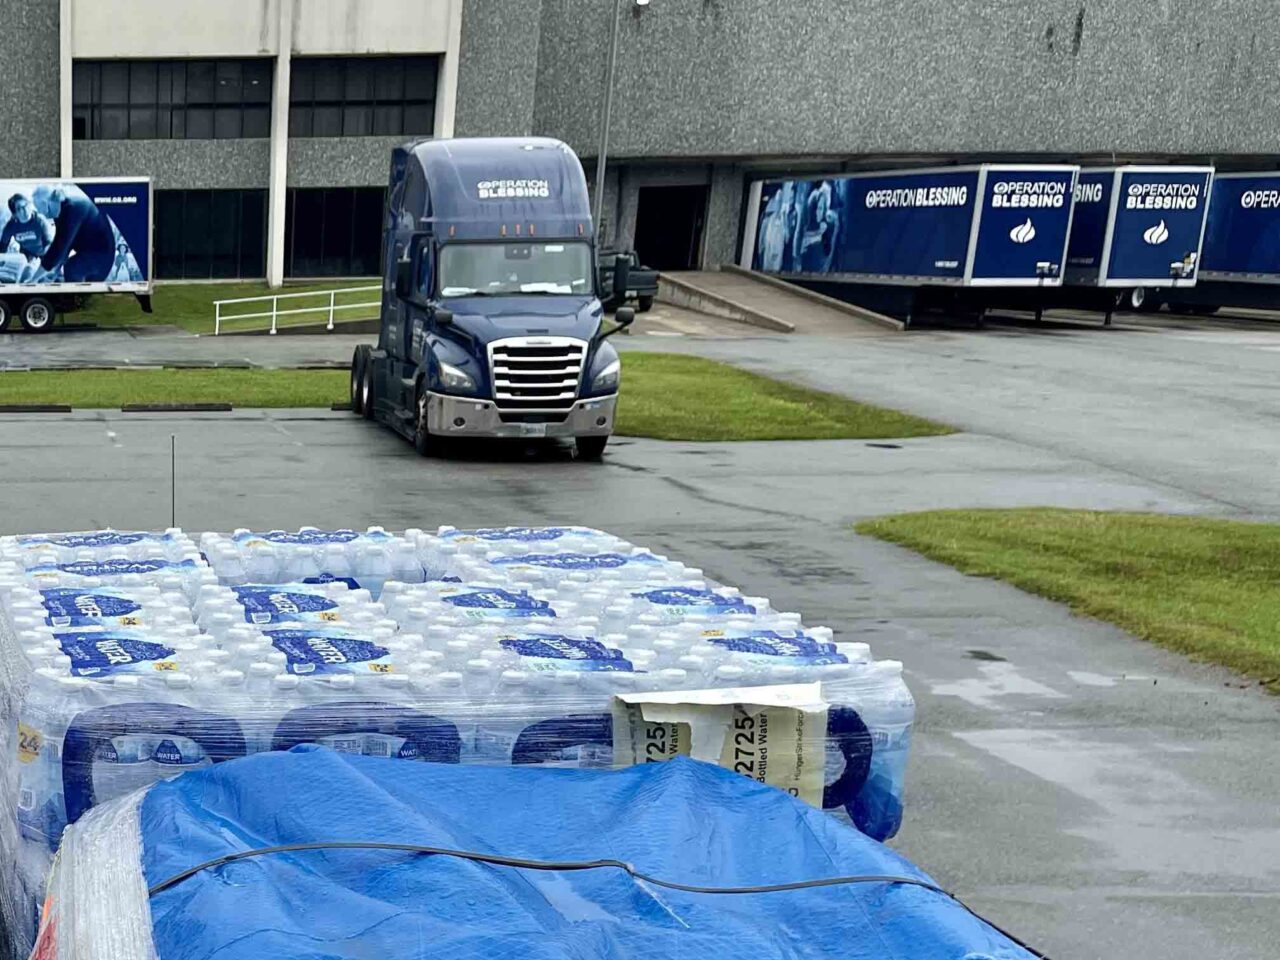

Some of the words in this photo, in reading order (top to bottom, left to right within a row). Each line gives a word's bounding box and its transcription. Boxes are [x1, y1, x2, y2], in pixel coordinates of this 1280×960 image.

[477, 179, 548, 189] OPERATION
[993, 181, 1066, 195] OPERATION
[1127, 183, 1200, 196] OPERATION
[479, 187, 549, 198] BLESSING
[866, 189, 916, 208] OPERATION
[915, 186, 967, 207] BLESSING
[991, 194, 1064, 208] BLESSING
[1126, 196, 1197, 209] BLESSING
[95, 639, 133, 665] WATER
[307, 637, 348, 664] WATER
[758, 713, 768, 745] Water
[734, 704, 755, 780] 2725
[157, 752, 181, 760] WATER
